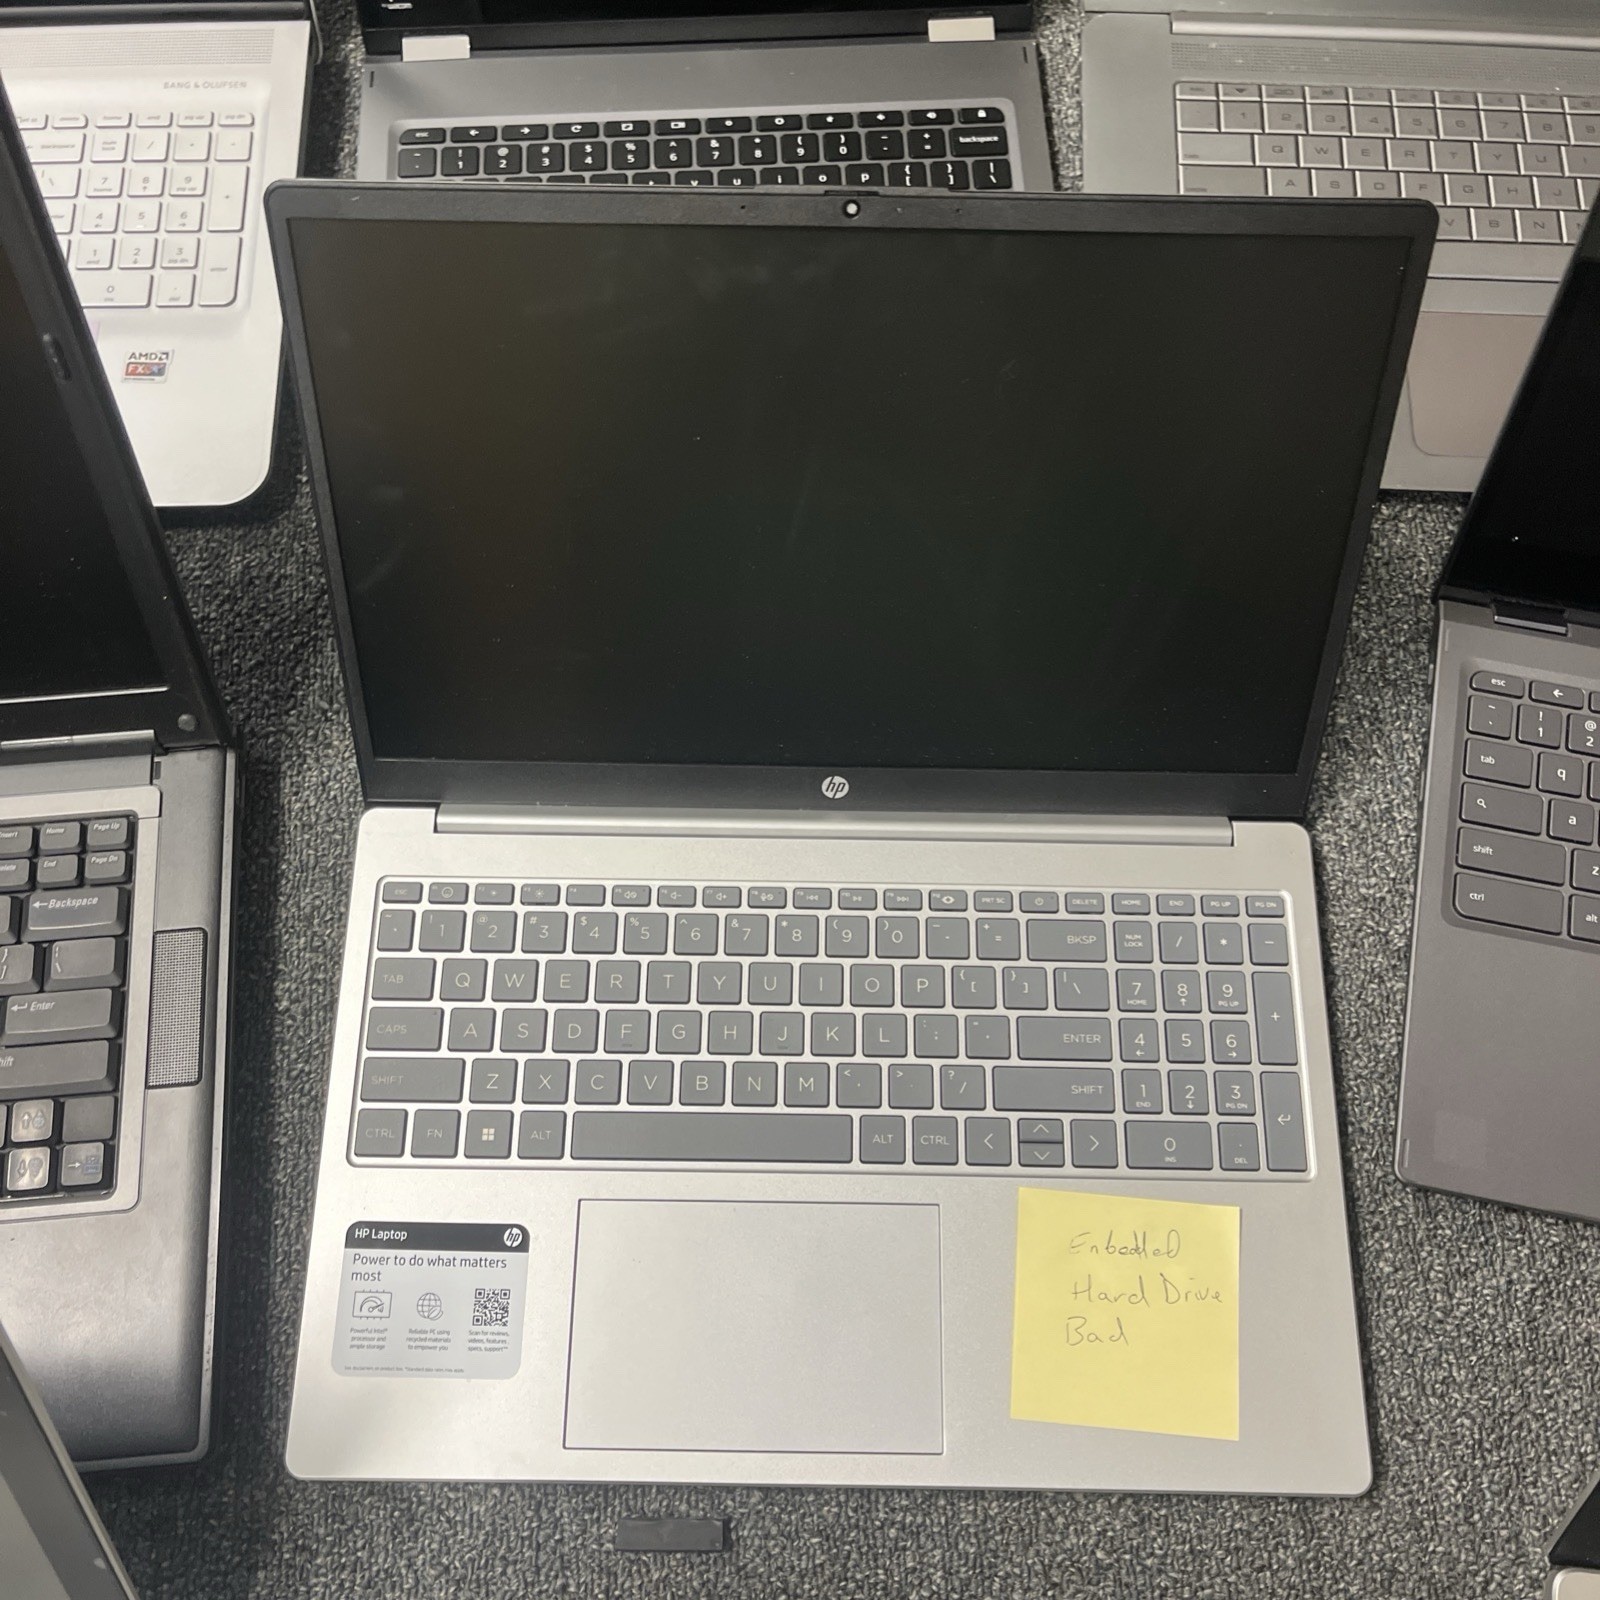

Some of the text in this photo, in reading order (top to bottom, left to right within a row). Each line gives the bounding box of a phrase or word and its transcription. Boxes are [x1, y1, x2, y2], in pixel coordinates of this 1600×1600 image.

[164, 81, 190, 89] BANG
[202, 81, 247, 89] OLUFSEN
[959, 135, 998, 143] backspace
[712, 152, 719, 160] 7
[754, 149, 762, 158] 8
[797, 148, 804, 156] 9
[840, 146, 847, 155] 0
[542, 158, 549, 167] 3
[584, 156, 592, 164] 4
[627, 154, 634, 163] 5
[670, 152, 677, 162] 6
[500, 159, 507, 168] 2
[818, 174, 827, 182] o
[128, 352, 158, 360] AMD
[1492, 677, 1506, 688] esc
[1538, 727, 1543, 737] 1
[1586, 736, 1594, 747] 2
[1480, 754, 1494, 765] tab
[1557, 768, 1566, 780] q
[822, 776, 850, 798] hp
[1568, 816, 1576, 825] a
[1473, 844, 1493, 856] shift
[1592, 866, 1600, 876] z
[48, 897, 98, 908] Backspace
[1470, 892, 1484, 901] ctrl
[1586, 913, 1598, 923] alt
[440, 924, 444, 936] 1
[488, 925, 497, 938] 2
[539, 926, 549, 938] 3
[590, 926, 600, 939] 4
[640, 927, 650, 939] 5
[691, 928, 700, 940] 6
[742, 929, 750, 941] 7
[792, 929, 802, 941] 8
[842, 930, 852, 942] 9
[892, 930, 903, 943] 0
[1066, 935, 1096, 944] BKSP
[383, 975, 404, 984] TAB
[455, 972, 471, 988] Q
[505, 973, 525, 988] W
[560, 974, 571, 988] E
[611, 974, 623, 989] R
[663, 975, 674, 989] T
[713, 976, 726, 990] Y
[764, 976, 777, 990] U
[819, 977, 823, 991] I
[865, 977, 880, 993] O
[917, 978, 929, 992] P
[1132, 983, 1142, 995] 7
[1177, 984, 1188, 996] 8
[1222, 984, 1233, 997] 9
[30, 1002, 56, 1011] Enter
[376, 1025, 407, 1034] CAPS
[463, 1024, 477, 1037] A
[517, 1024, 529, 1038] S
[568, 1024, 581, 1038] D
[622, 1024, 632, 1038] F
[672, 1024, 686, 1039] G
[724, 1025, 736, 1039] H
[778, 1026, 787, 1041] J
[827, 1027, 839, 1041] K
[880, 1028, 890, 1042] L
[1063, 1034, 1101, 1043] ENTER
[1135, 1033, 1145, 1046] 4
[1181, 1034, 1191, 1047] 5
[1226, 1034, 1237, 1048] 6
[371, 1075, 404, 1085] SHIFT
[486, 1074, 499, 1089] Z
[538, 1075, 551, 1089] X
[590, 1075, 604, 1090] C
[644, 1075, 657, 1090] V
[696, 1076, 708, 1091] B
[748, 1077, 761, 1091] N
[799, 1077, 814, 1092] M
[1071, 1085, 1104, 1095] SHIFT
[1140, 1085, 1146, 1097] 1
[1185, 1085, 1195, 1098] 2
[1231, 1086, 1241, 1099] 3
[365, 1128, 395, 1138] CTRL
[427, 1129, 443, 1138] FN
[530, 1130, 551, 1140] ALT
[872, 1135, 893, 1144] ALT
[920, 1135, 949, 1145] CTRL
[1163, 1137, 1176, 1151] 0
[355, 1228, 407, 1241] HP Laptop
[504, 1228, 522, 1247] hp
[352, 1253, 507, 1268] Power to do what matters
[351, 1271, 382, 1282] most
[1072, 1272, 1223, 1307] Hard Drive
[1066, 1316, 1129, 1346] Bad
